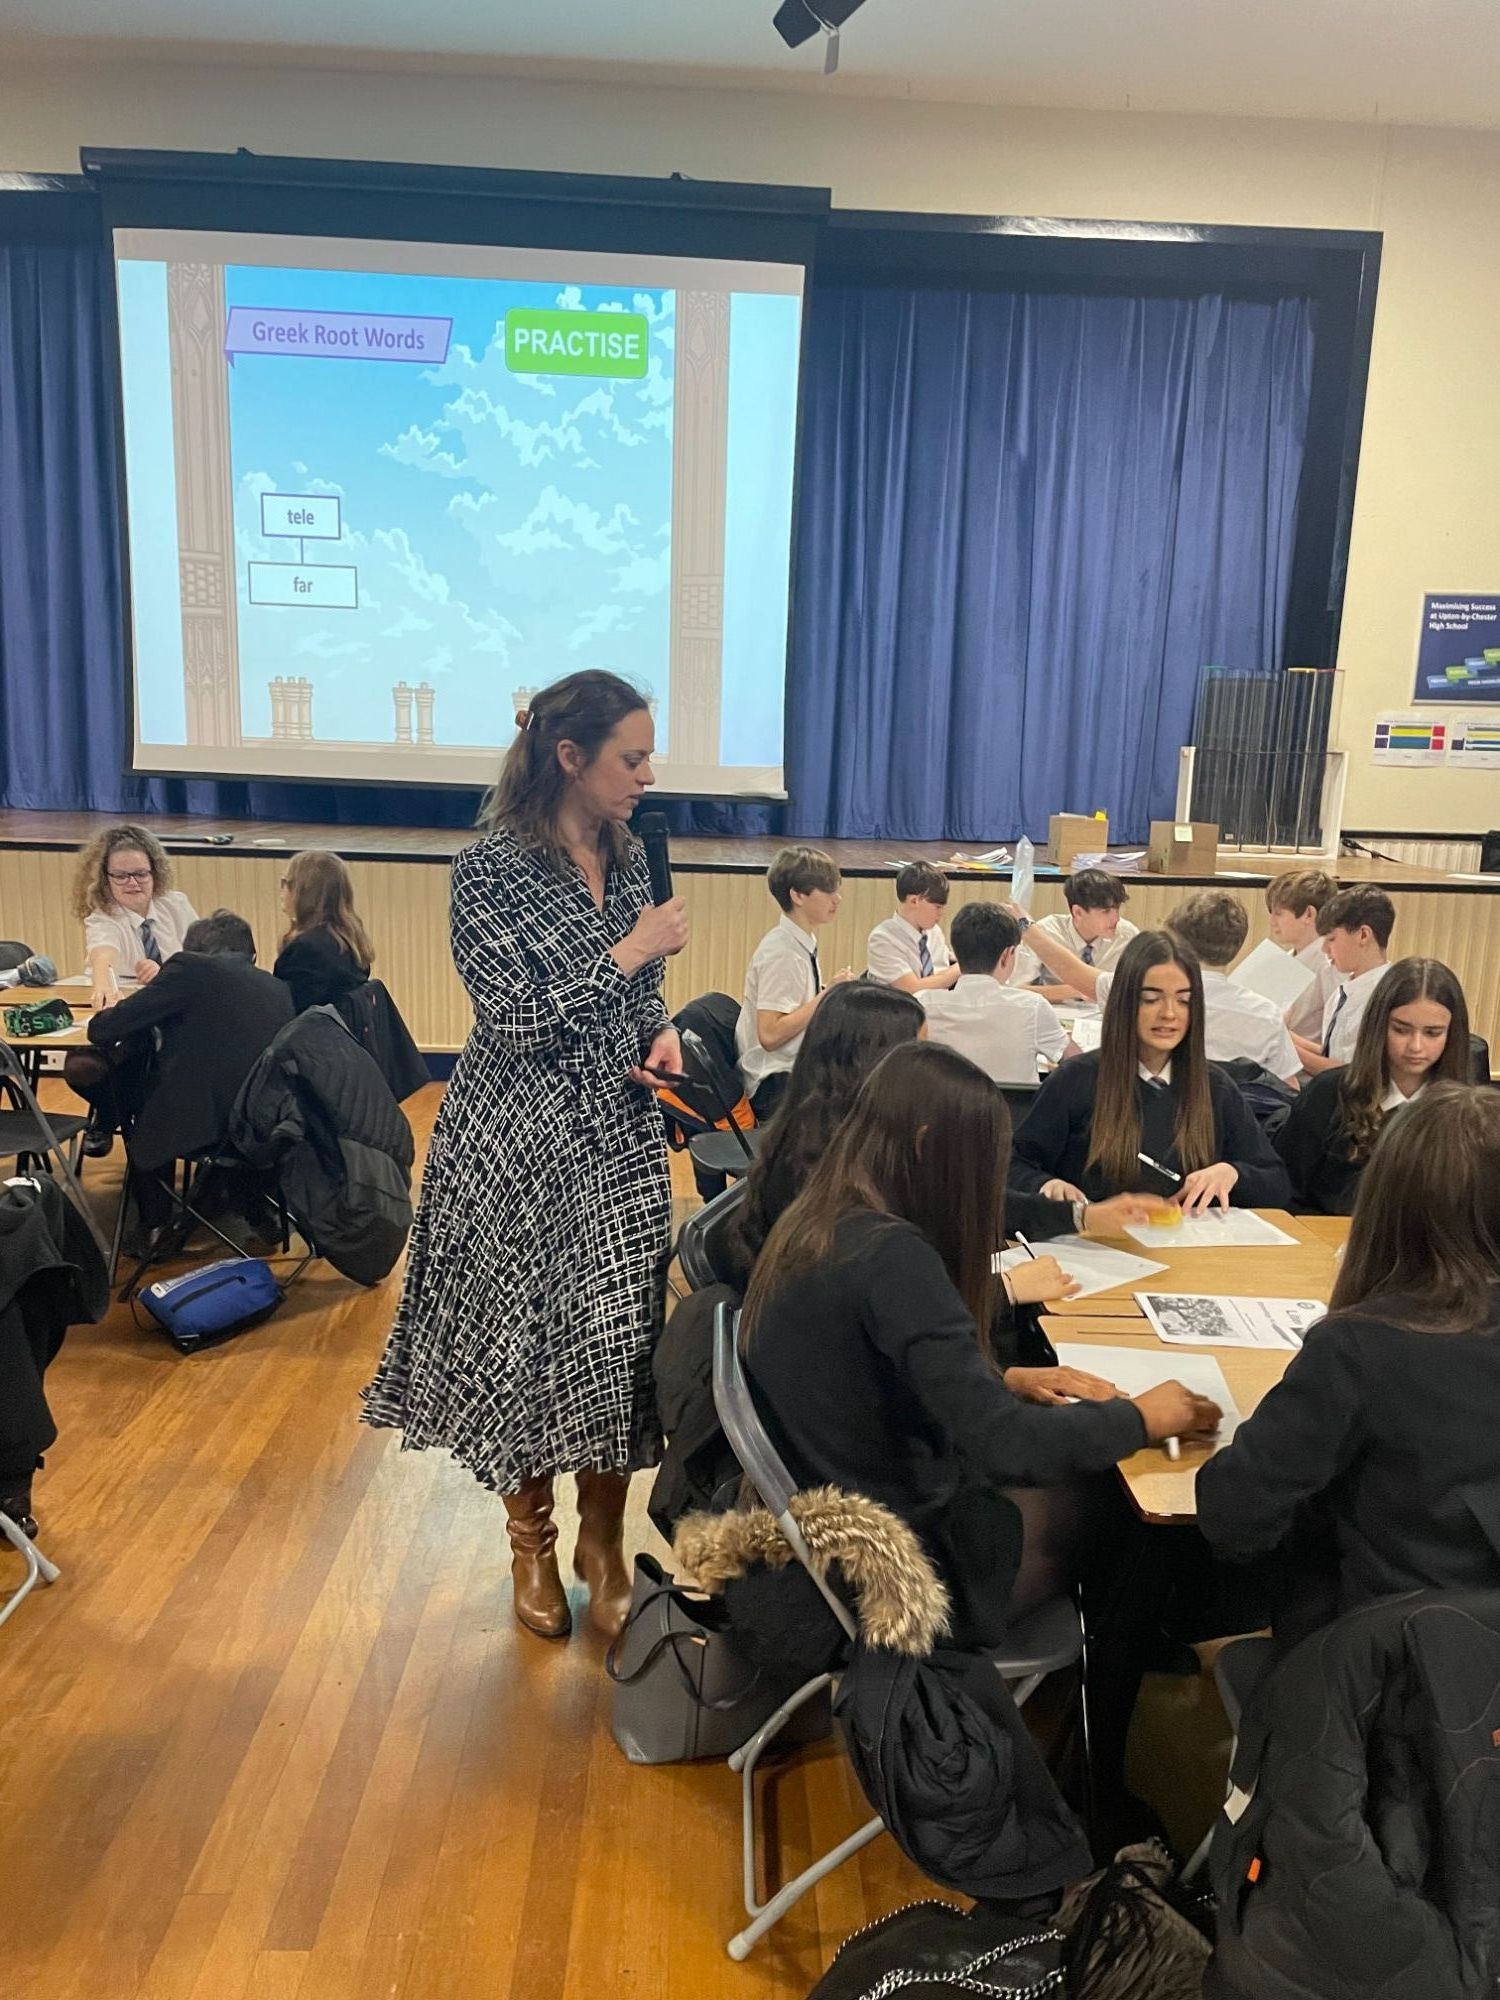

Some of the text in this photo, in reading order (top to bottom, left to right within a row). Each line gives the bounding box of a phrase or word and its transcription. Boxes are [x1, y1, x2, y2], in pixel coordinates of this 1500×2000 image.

[252, 320, 425, 350] Greek Root Words
[514, 327, 640, 360] PRACTISE
[287, 508, 315, 525] tele
[293, 576, 313, 593] far
[1431, 602, 1497, 612] Maximising Success
[1430, 612, 1498, 622] at Upton-by-Chester
[1429, 621, 1469, 631] High School
